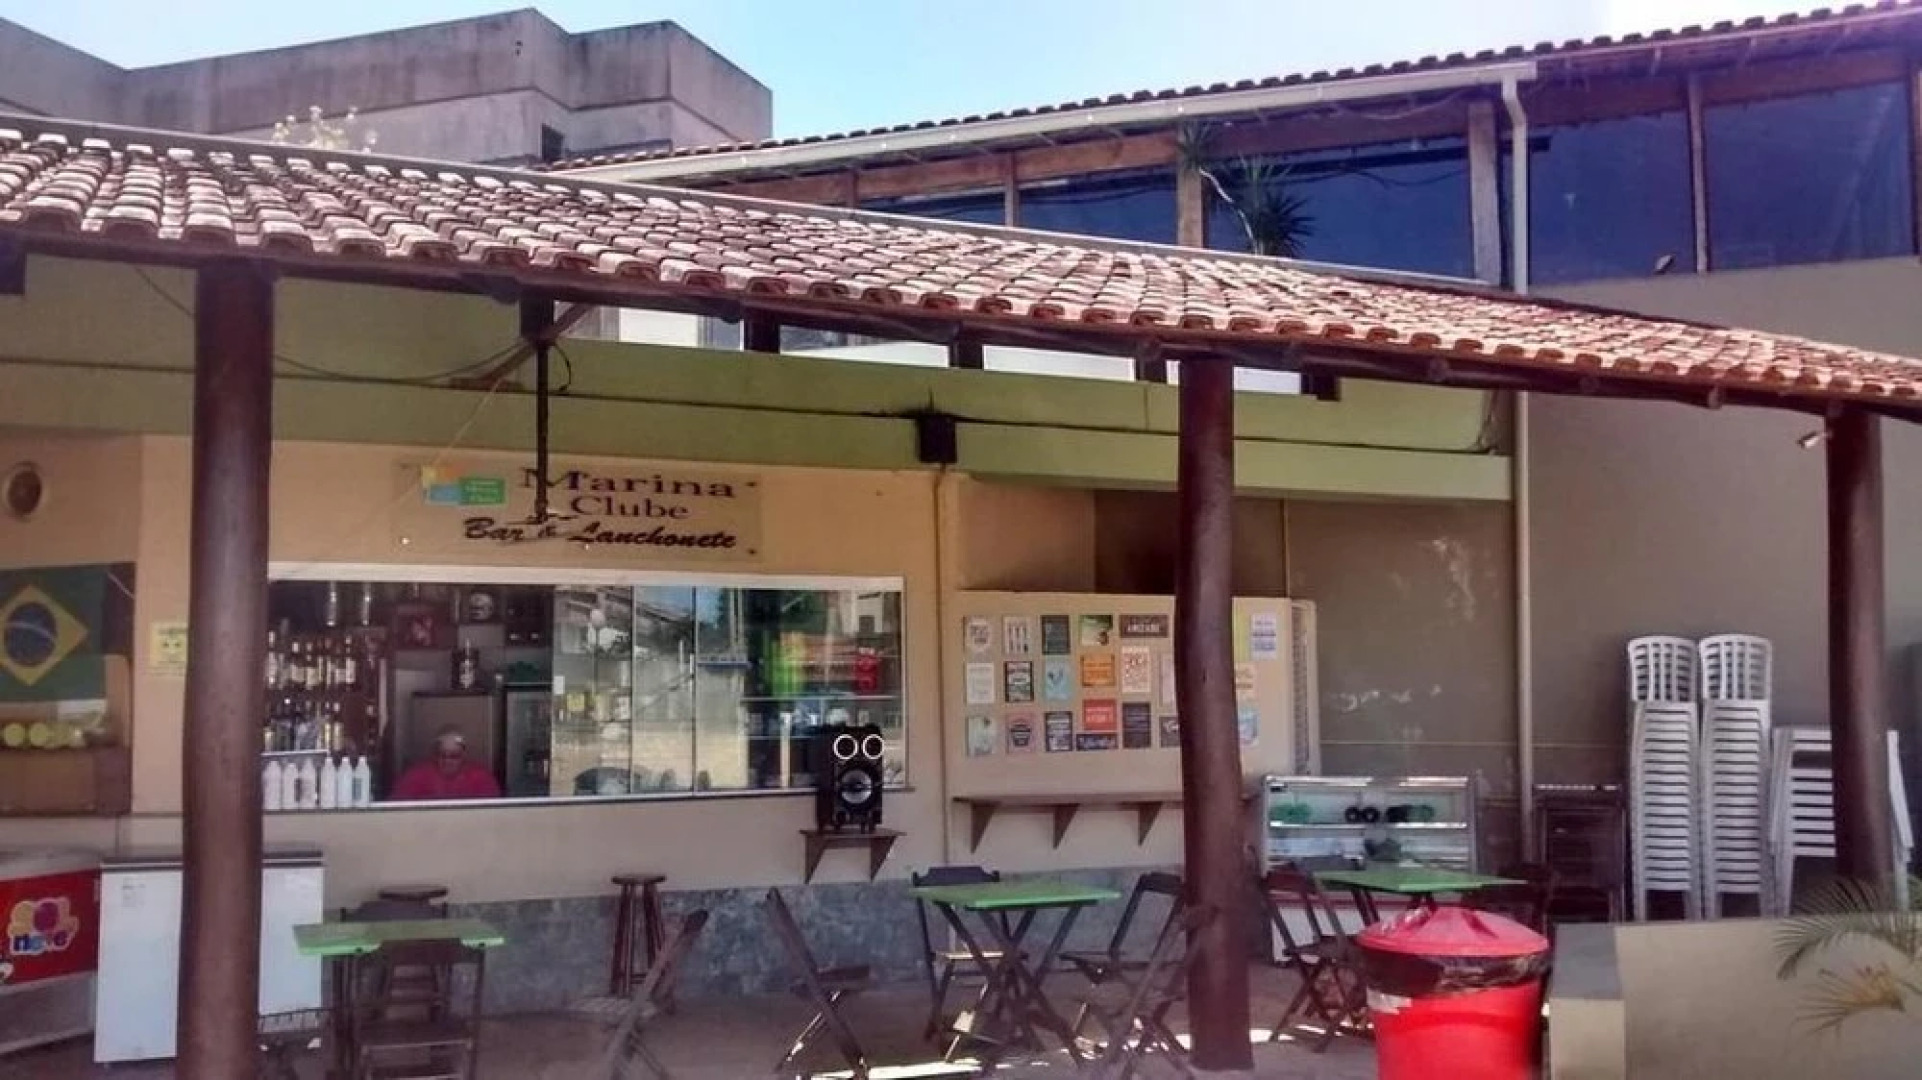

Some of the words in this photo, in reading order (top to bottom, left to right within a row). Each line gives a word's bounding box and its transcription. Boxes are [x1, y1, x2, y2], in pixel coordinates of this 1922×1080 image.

[521, 467, 736, 498] Marina
[570, 495, 690, 519] Clube
[463, 516, 524, 541] Bar
[567, 521, 738, 549] Lanchonete
